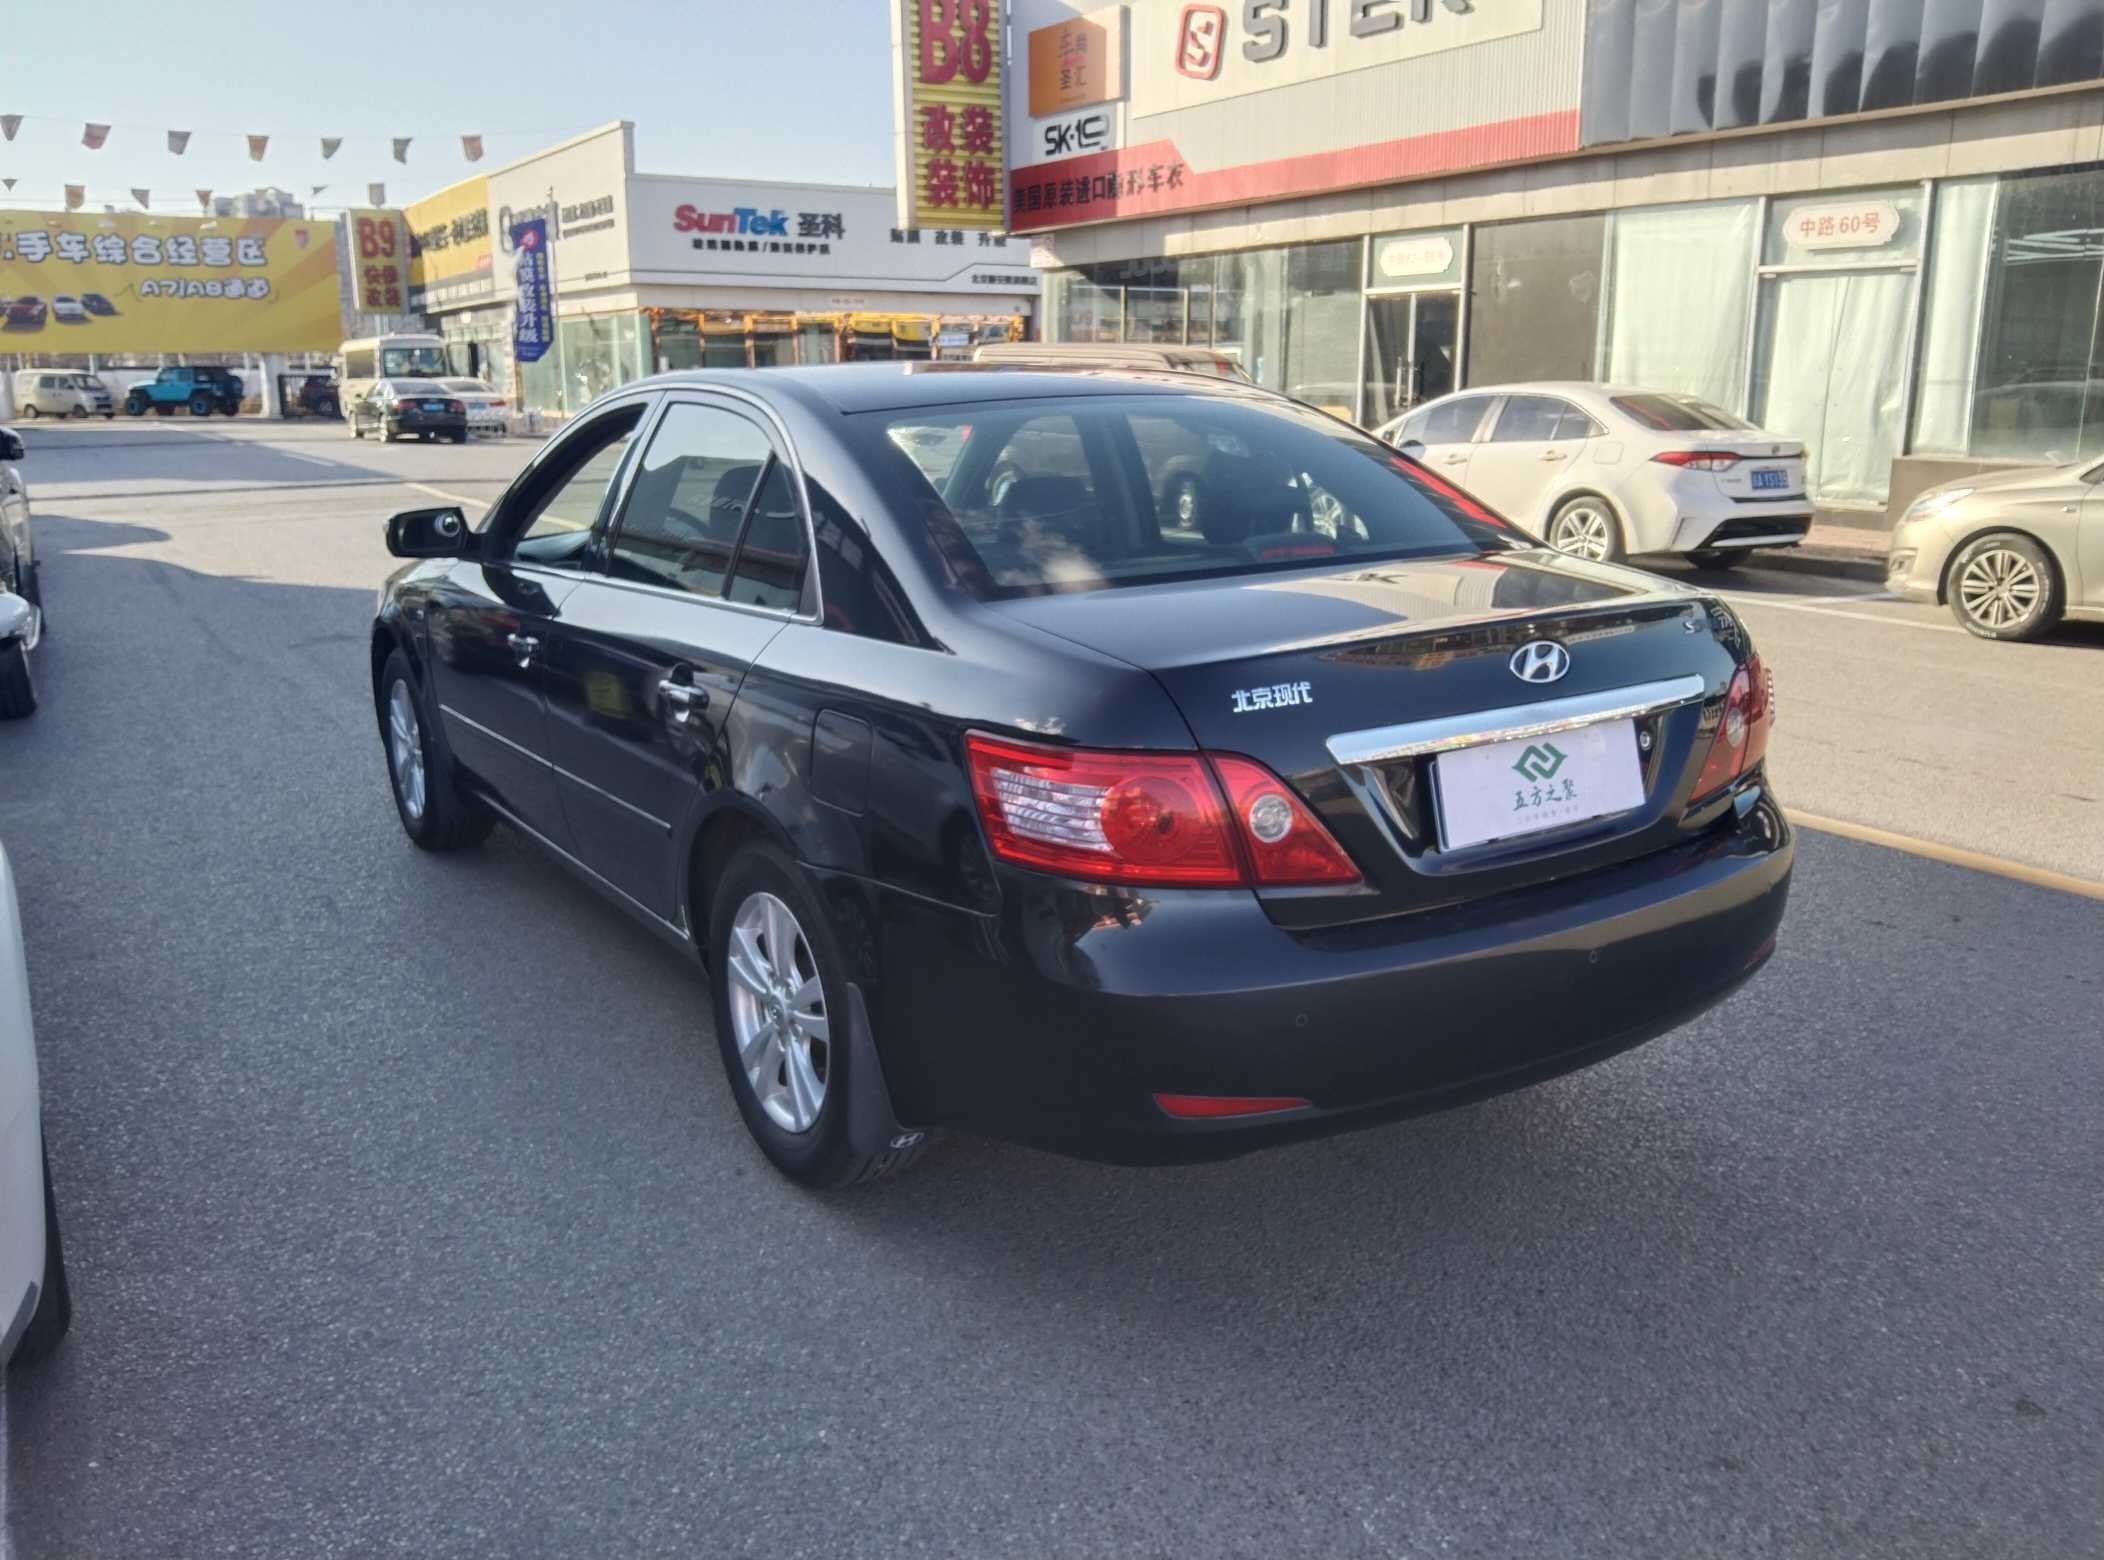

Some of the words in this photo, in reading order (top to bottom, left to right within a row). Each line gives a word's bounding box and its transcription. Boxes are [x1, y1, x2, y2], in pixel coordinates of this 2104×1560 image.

[919, 0, 991, 84] B8
[920, 104, 994, 154] 改装
[926, 158, 996, 208] 装饰
[357, 217, 395, 258] B9
[673, 204, 789, 237] SunTek
[1800, 212, 1880, 238] 中路60号
[3, 231, 266, 266] 手车综合经营区
[1230, 680, 1314, 713] 北京现代
